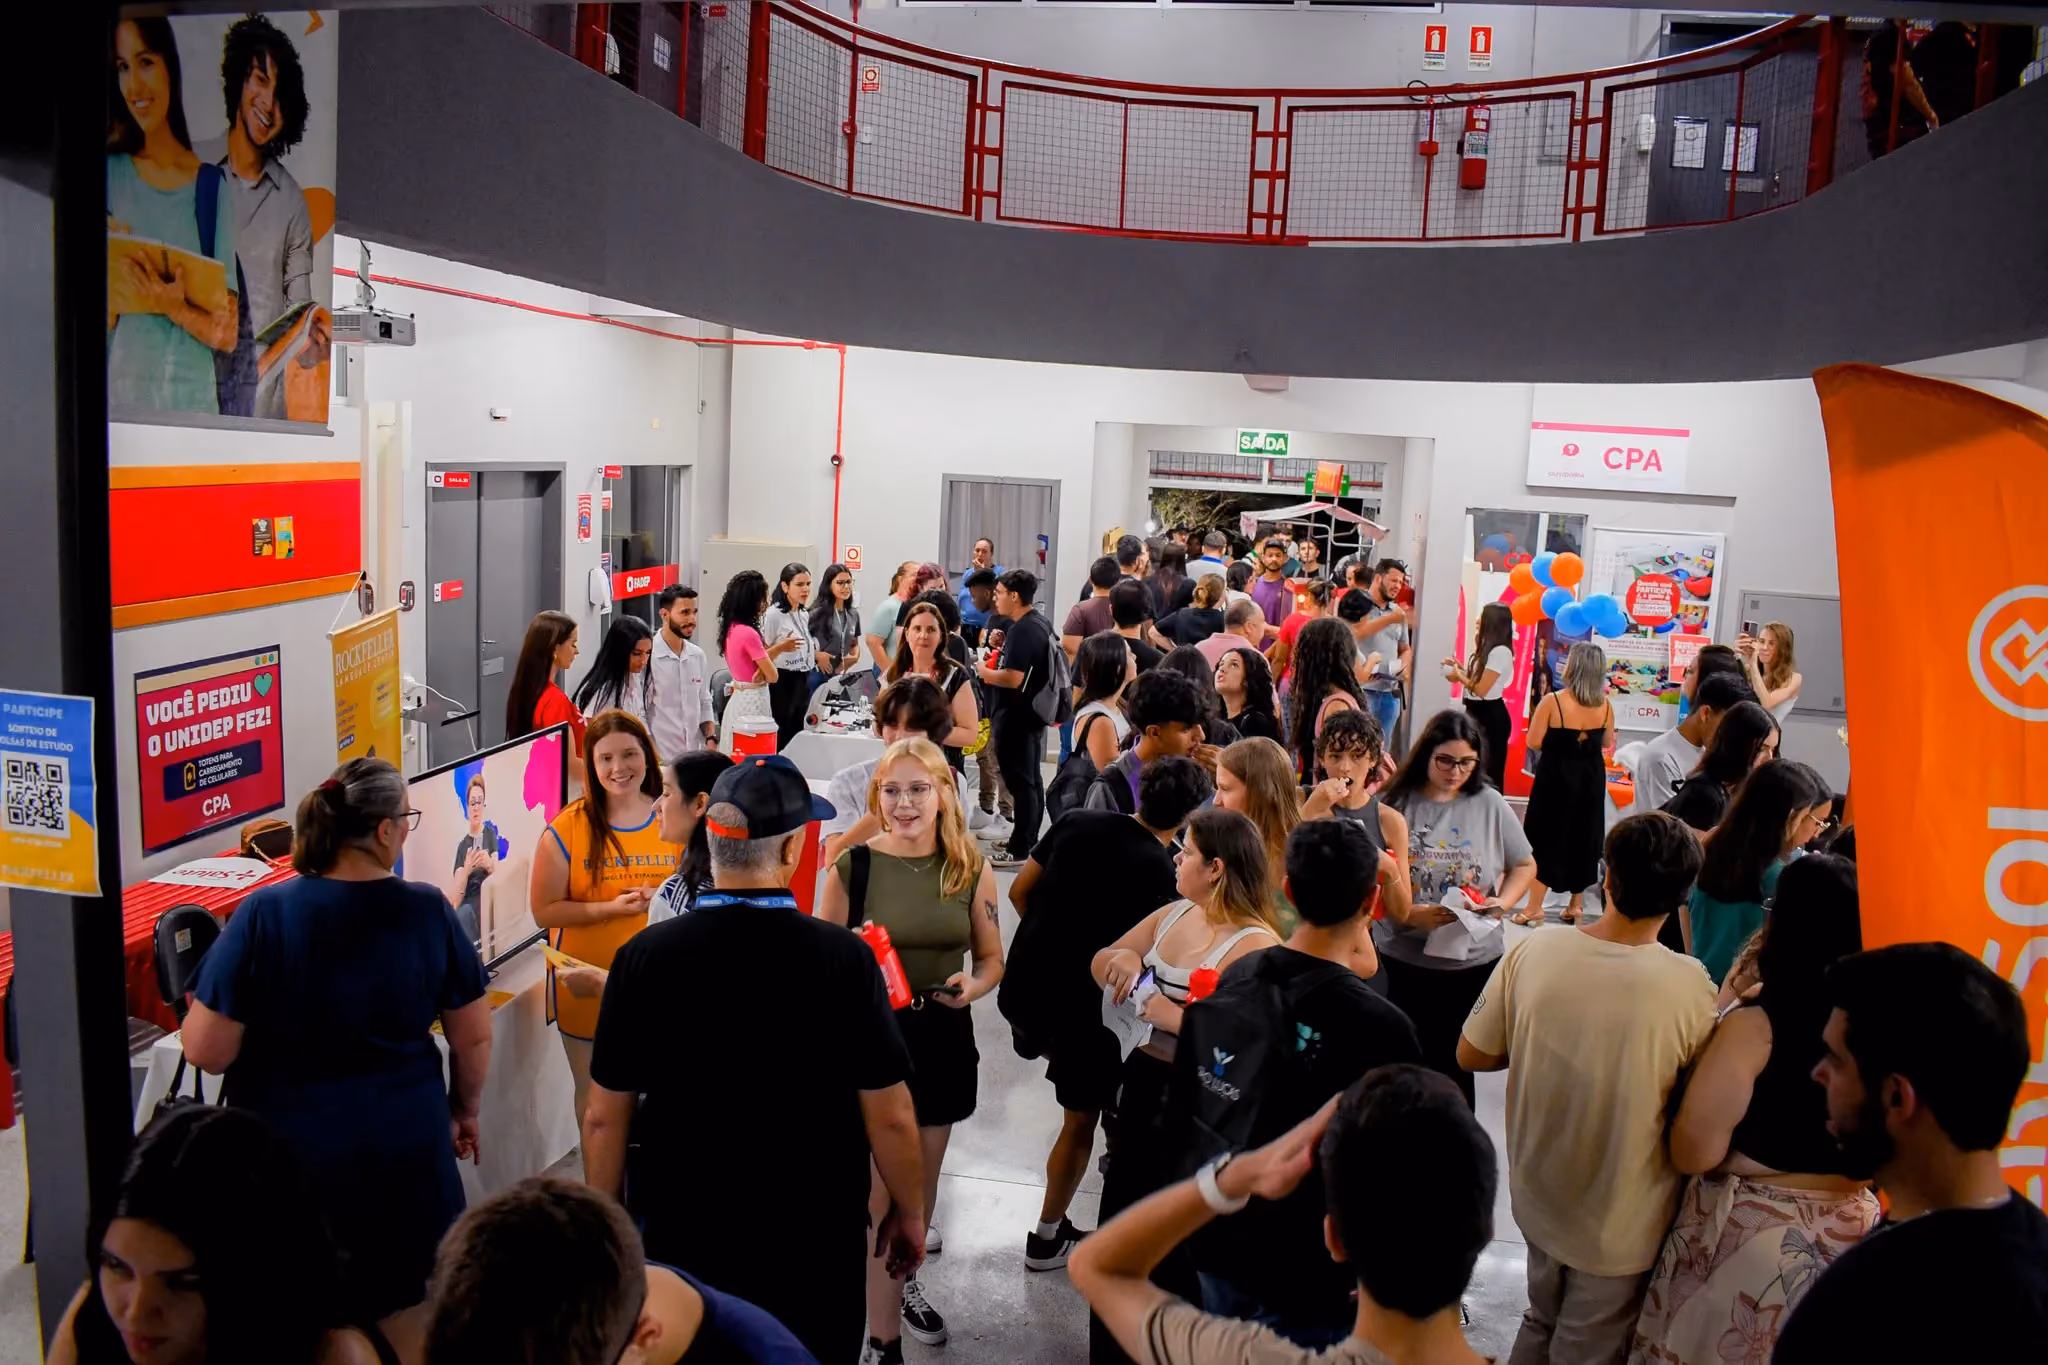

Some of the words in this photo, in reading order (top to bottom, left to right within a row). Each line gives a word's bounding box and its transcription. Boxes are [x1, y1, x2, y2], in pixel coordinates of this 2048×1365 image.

[1603, 447, 1663, 472] CPA
[335, 628, 395, 675] ROCKFELLER
[3, 703, 64, 720] PARTICIPE
[146, 689, 195, 726] VOCÊ
[197, 682, 252, 713] PEDIU
[1637, 707, 1660, 717] CPA
[45, 727, 58, 737] DE
[148, 735, 161, 757] O
[165, 716, 234, 752] UNIDEP
[236, 706, 272, 733] FEZ!
[0, 737, 25, 746] OLSAS
[26, 738, 38, 748] DE
[39, 740, 74, 752] ESTUDO
[198, 755, 219, 767] TOTENS
[219, 752, 233, 761] PARA
[199, 758, 243, 777] CARREGAMENTO
[200, 778, 208, 787] DE
[207, 769, 238, 784] CELULARES
[202, 793, 231, 816] CPA
